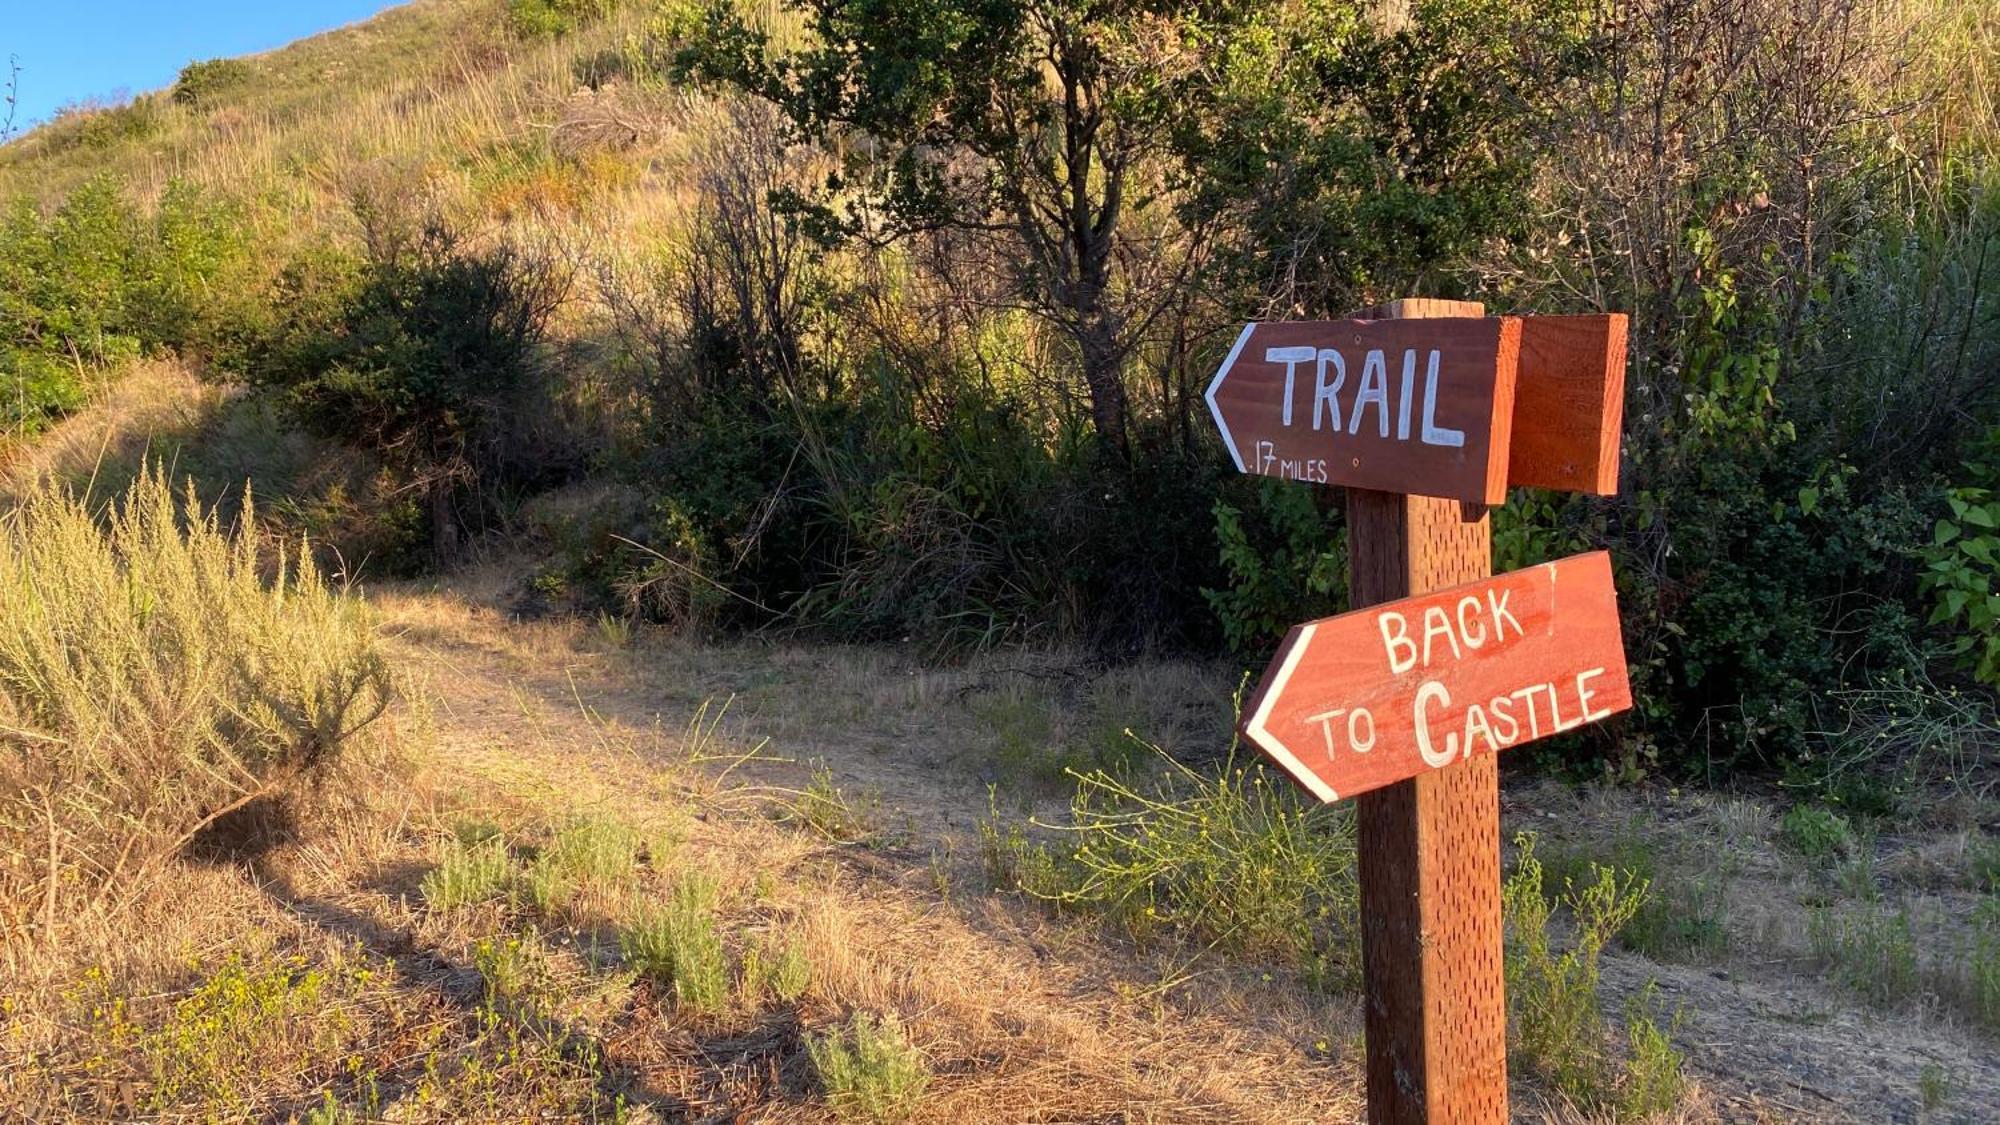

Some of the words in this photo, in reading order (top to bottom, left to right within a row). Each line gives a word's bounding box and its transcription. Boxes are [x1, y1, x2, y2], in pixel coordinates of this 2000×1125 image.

[1265, 346, 1466, 447] TRAIL
[1280, 458, 1329, 484] MILES
[1378, 588, 1525, 675] BACK
[1304, 707, 1377, 761] TO
